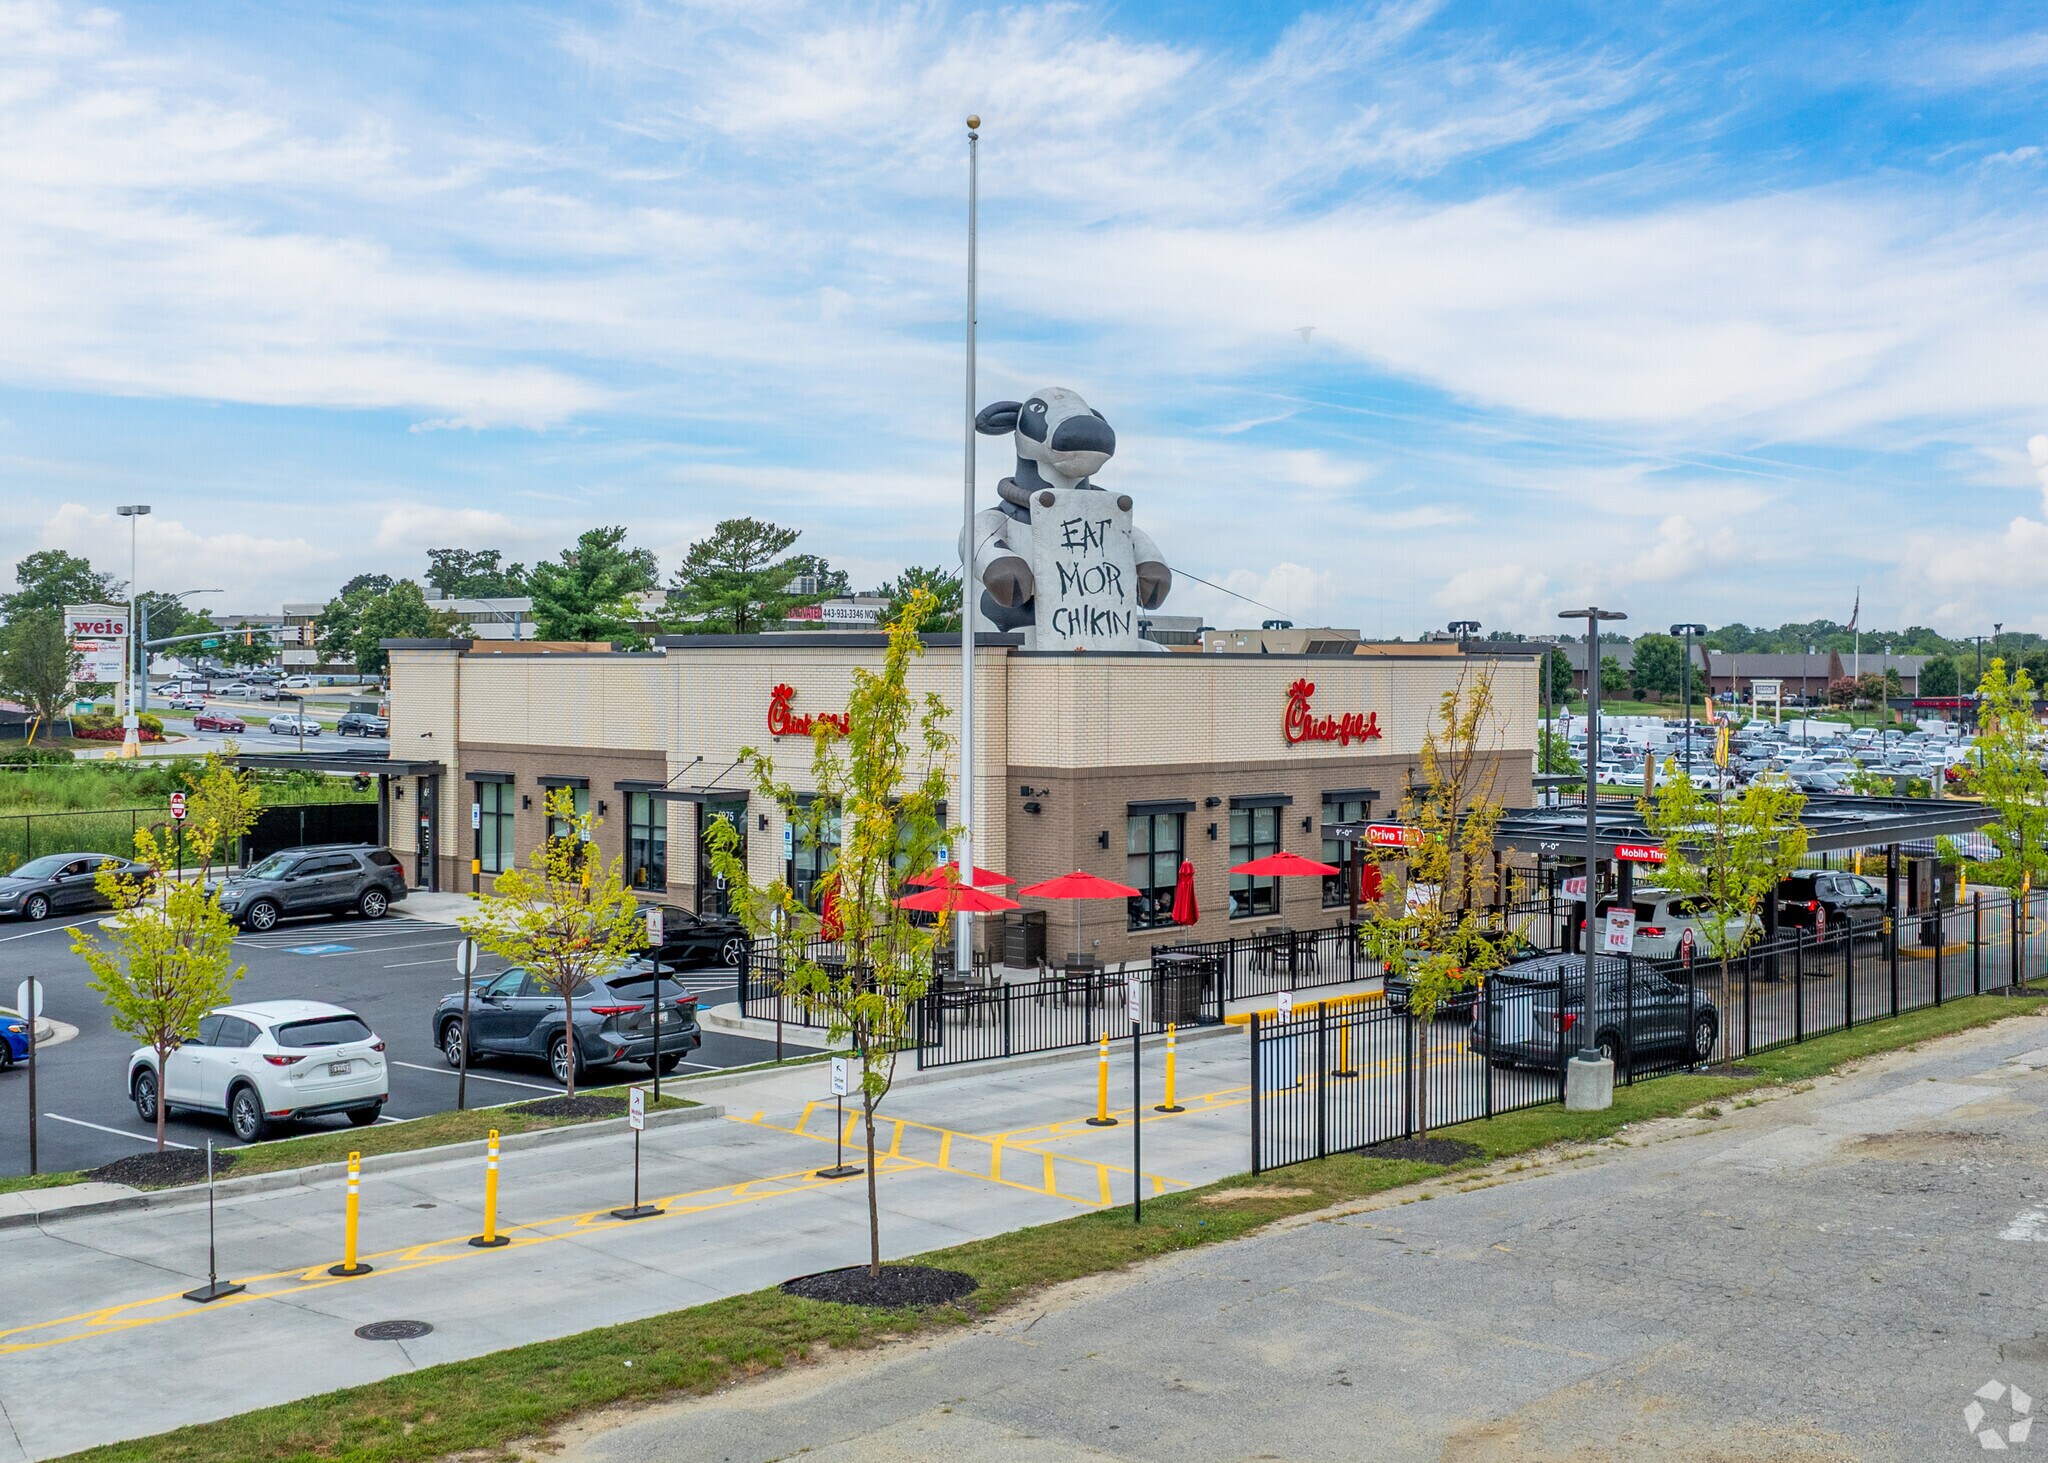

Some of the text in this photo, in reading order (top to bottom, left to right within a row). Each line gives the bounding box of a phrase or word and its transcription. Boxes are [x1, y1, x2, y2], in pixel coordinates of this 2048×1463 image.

[1060, 517, 1112, 556] EAT
[1056, 561, 1125, 602] MOR
[786, 605, 822, 620] ENOVATED
[823, 608, 864, 619] 443-931-3346
[1052, 604, 1131, 639] CHIKIN
[73, 619, 123, 634] weis
[1284, 690, 1382, 746] Chick-fil-A
[1370, 829, 1419, 843] Drive Th
[1621, 847, 1648, 859] Mobile
